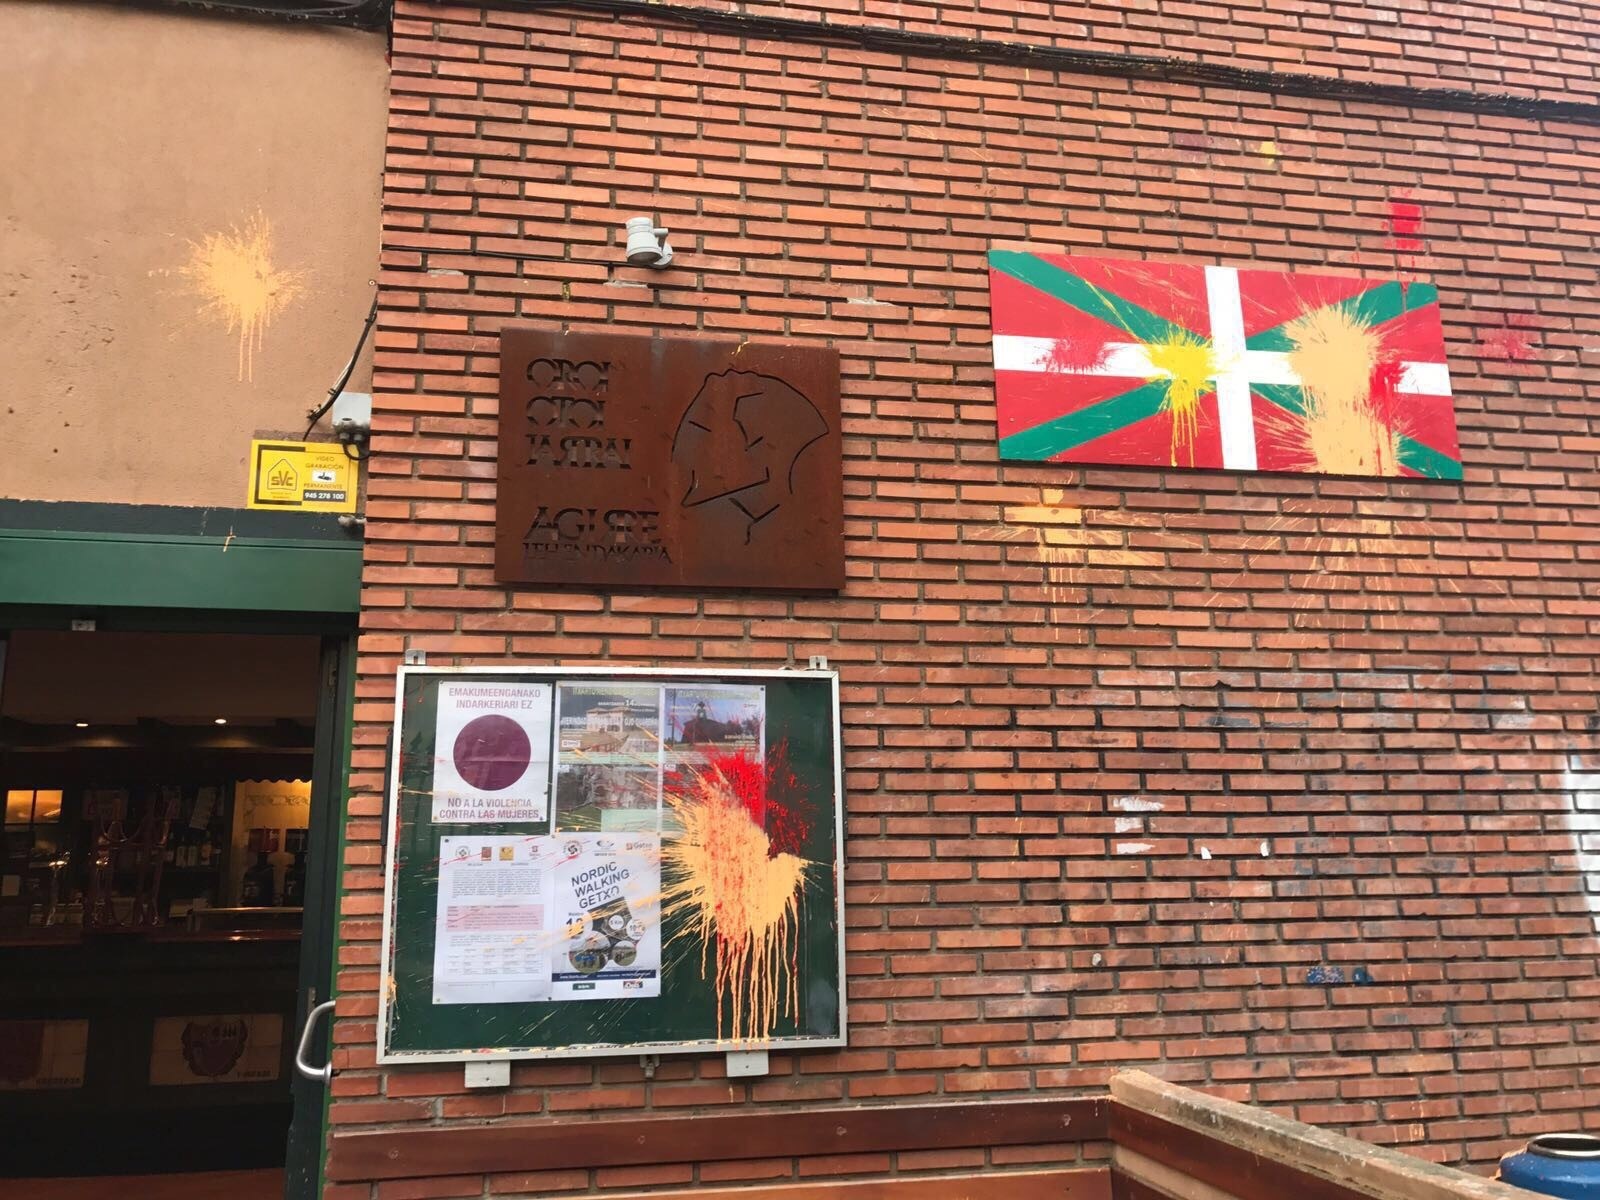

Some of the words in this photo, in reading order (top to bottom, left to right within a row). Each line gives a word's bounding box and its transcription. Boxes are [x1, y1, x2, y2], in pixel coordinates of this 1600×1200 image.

[448, 687, 541, 698] EMAKUMEENGANAKO
[456, 699, 518, 709] INDARKERIARI
[521, 700, 533, 710] EZ
[447, 798, 462, 808] NO
[464, 799, 470, 807] A
[472, 799, 484, 808] LA
[486, 798, 532, 808] VIOLENCIA
[439, 809, 475, 819] CONTRA
[477, 809, 496, 819] LAS
[497, 809, 540, 819] MUJERES
[571, 861, 618, 887] NORDIC
[574, 868, 630, 898] WALKING
